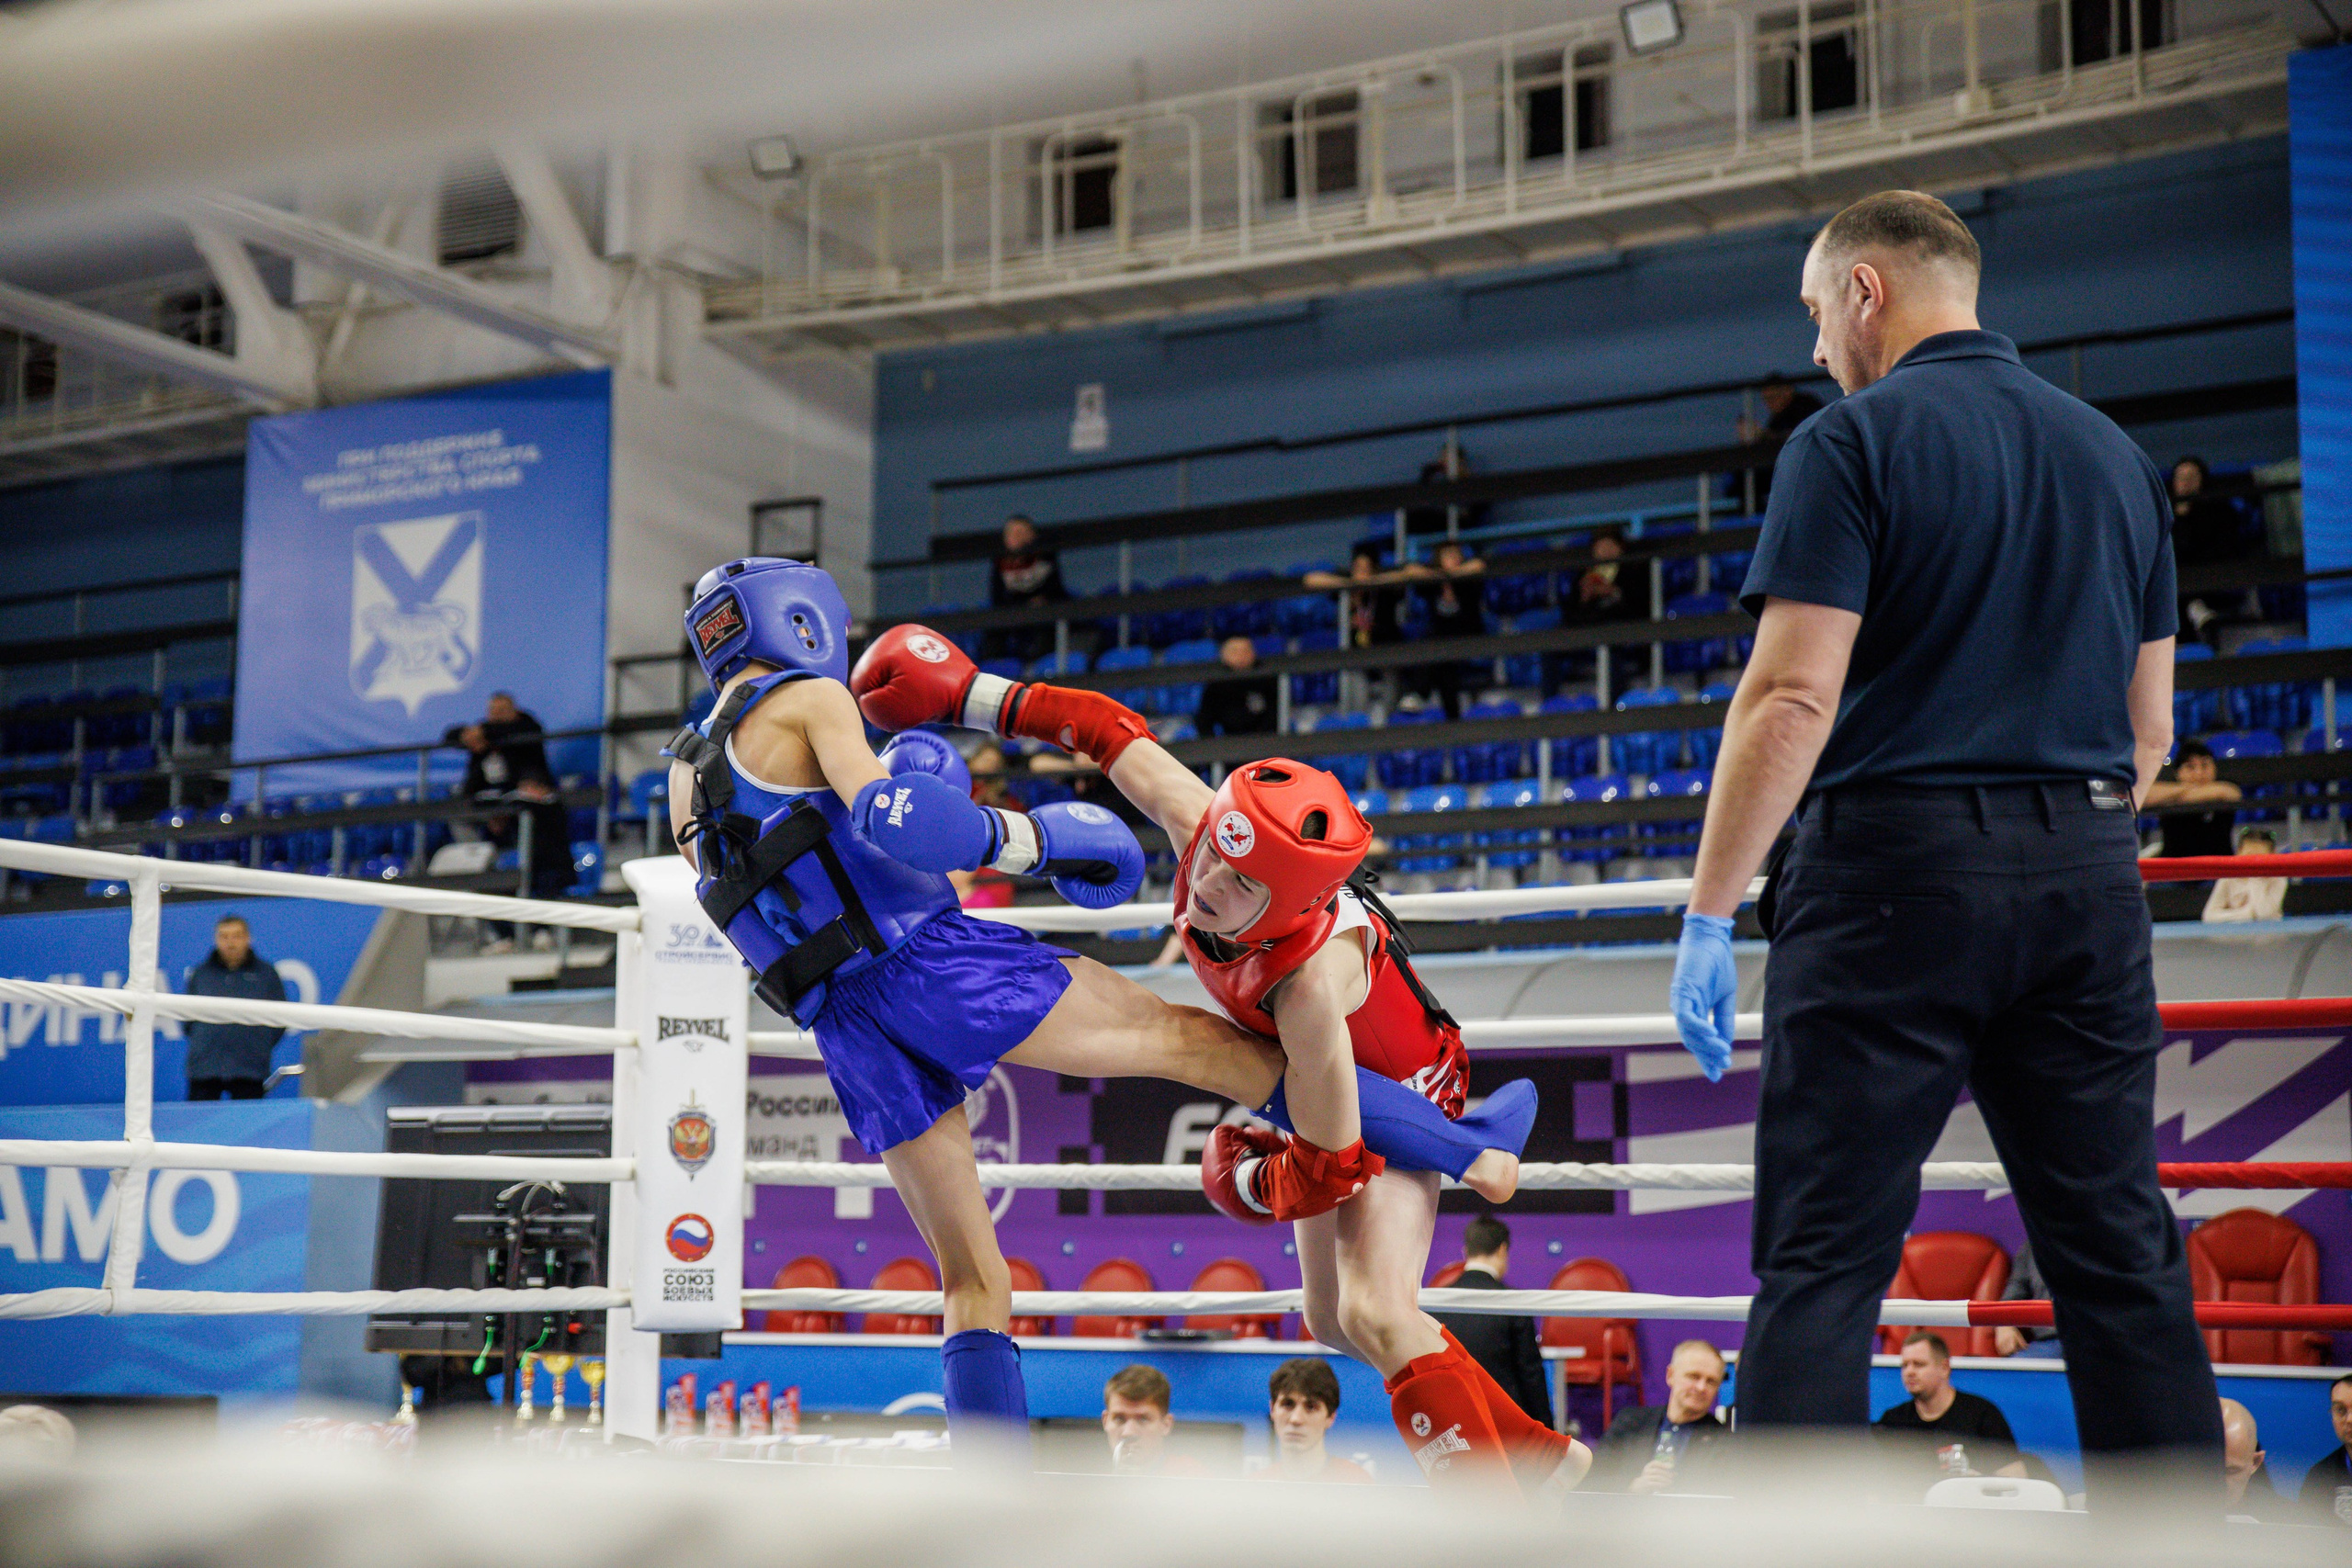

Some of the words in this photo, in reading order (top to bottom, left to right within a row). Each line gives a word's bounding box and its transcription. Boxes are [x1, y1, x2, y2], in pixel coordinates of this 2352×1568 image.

[698, 607, 740, 649] REYVEL
[887, 787, 912, 828] REYVEL
[657, 1015, 731, 1043] REYVEL
[663, 1286, 714, 1294] БОЕВЫХ
[664, 1274, 714, 1286] СОЮЗ
